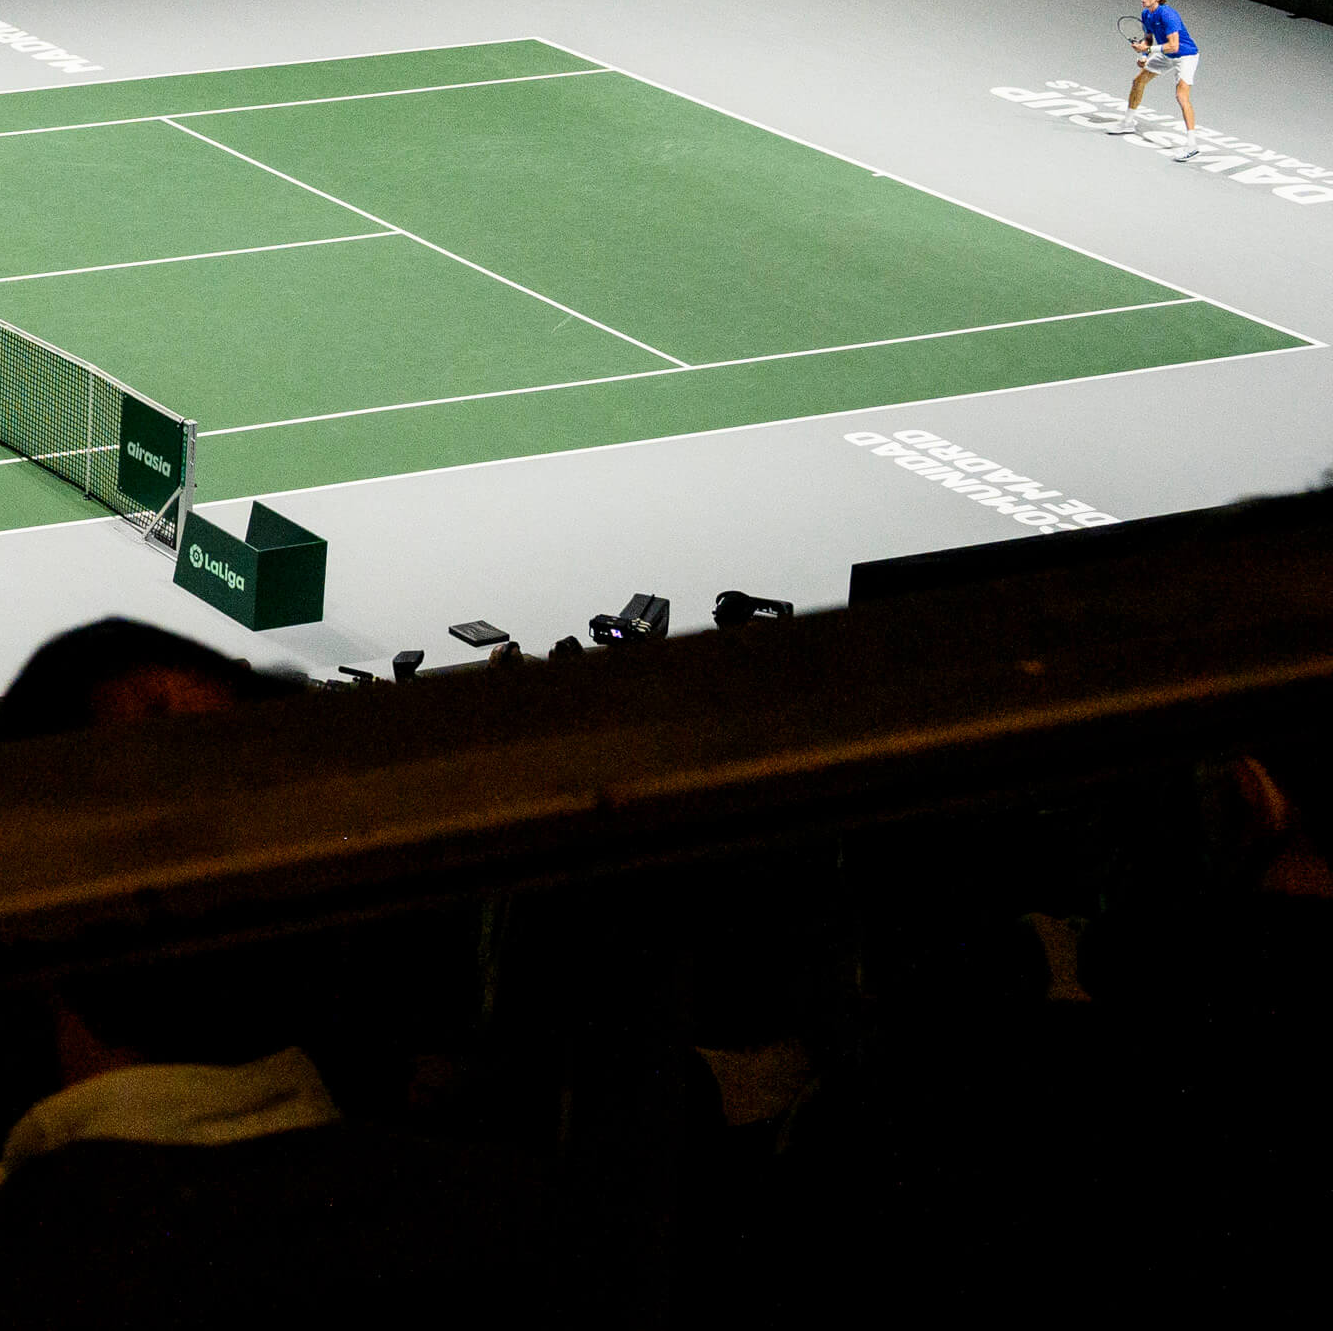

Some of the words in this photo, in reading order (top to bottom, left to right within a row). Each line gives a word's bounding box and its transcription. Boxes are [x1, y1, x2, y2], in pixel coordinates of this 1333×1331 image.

[990, 86, 1138, 133] CUP
[127, 441, 171, 478] airasia
[893, 430, 1063, 500] MADRID
[204, 553, 245, 592] LaLiga
